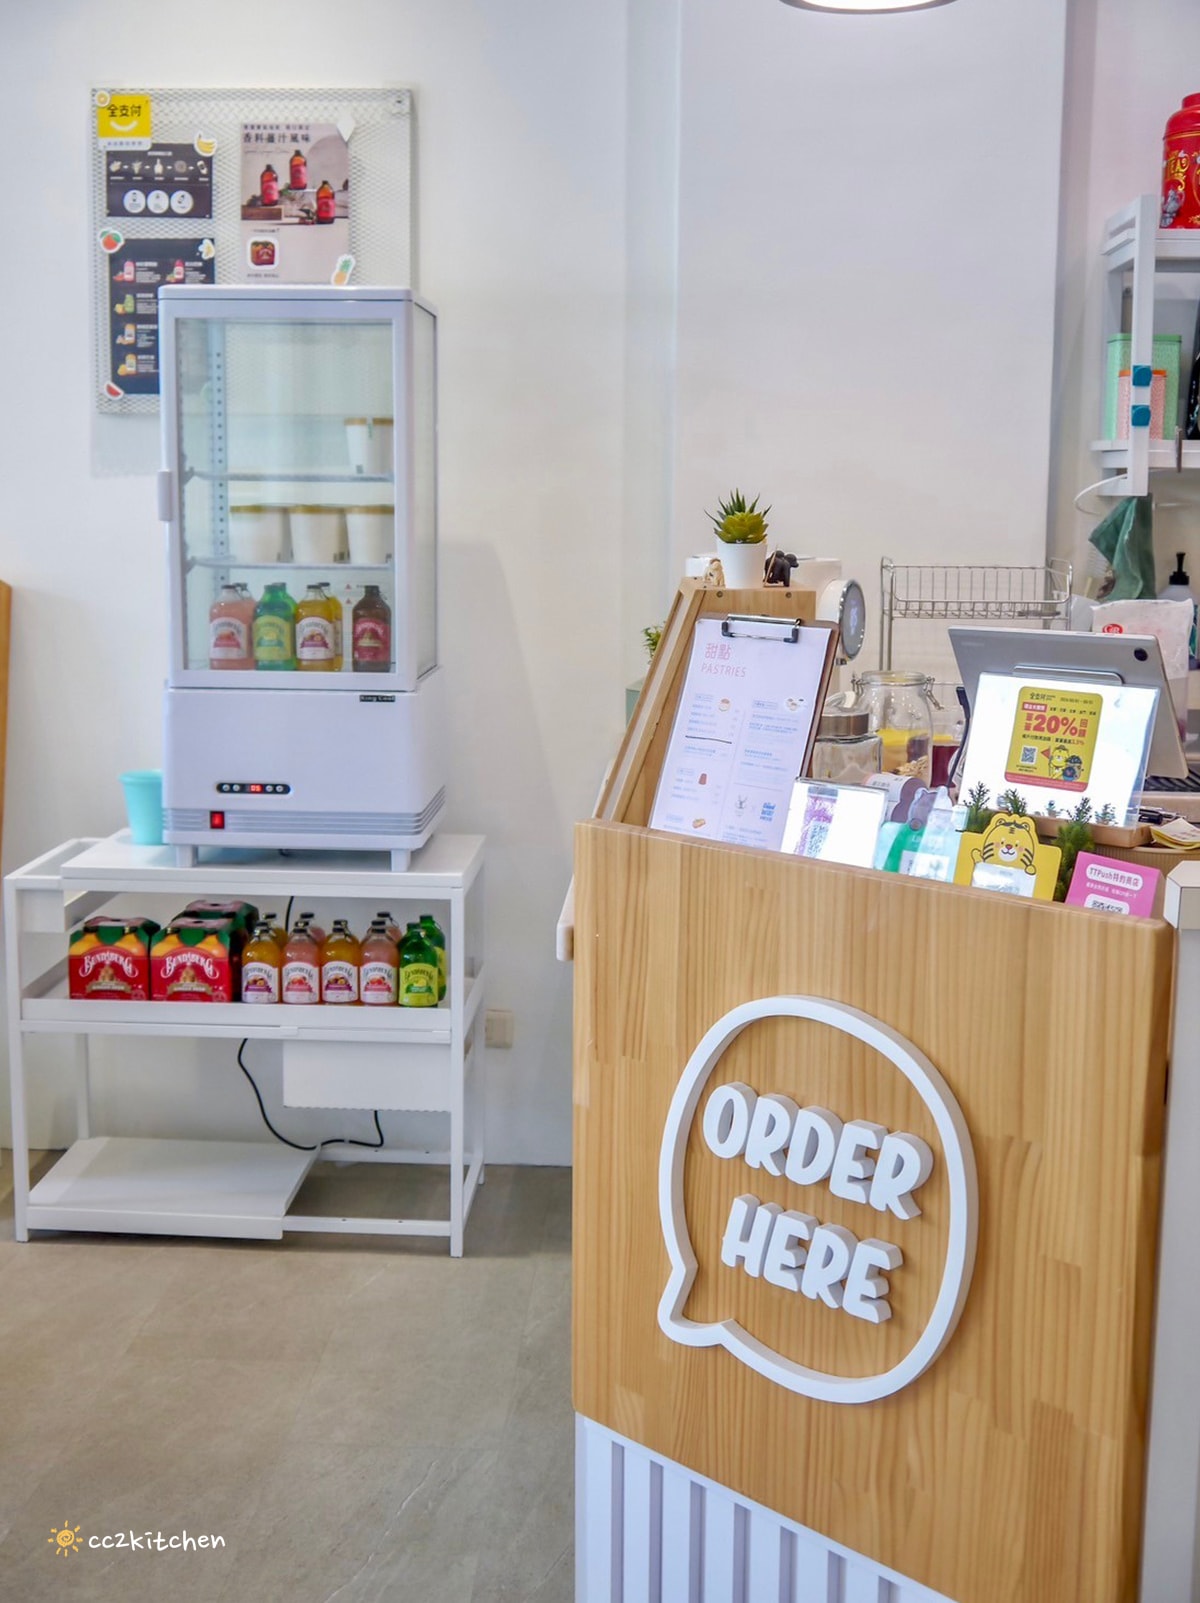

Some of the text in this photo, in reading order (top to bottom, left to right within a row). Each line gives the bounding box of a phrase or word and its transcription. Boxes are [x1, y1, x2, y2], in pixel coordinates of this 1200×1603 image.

[107, 104, 142, 118] 全支付
[705, 643, 732, 661] 甜點
[701, 663, 747, 678] PASTRIES
[1033, 714, 1078, 737] 20%
[703, 1081, 934, 1220] ORDER
[721, 1193, 904, 1324] HERE
